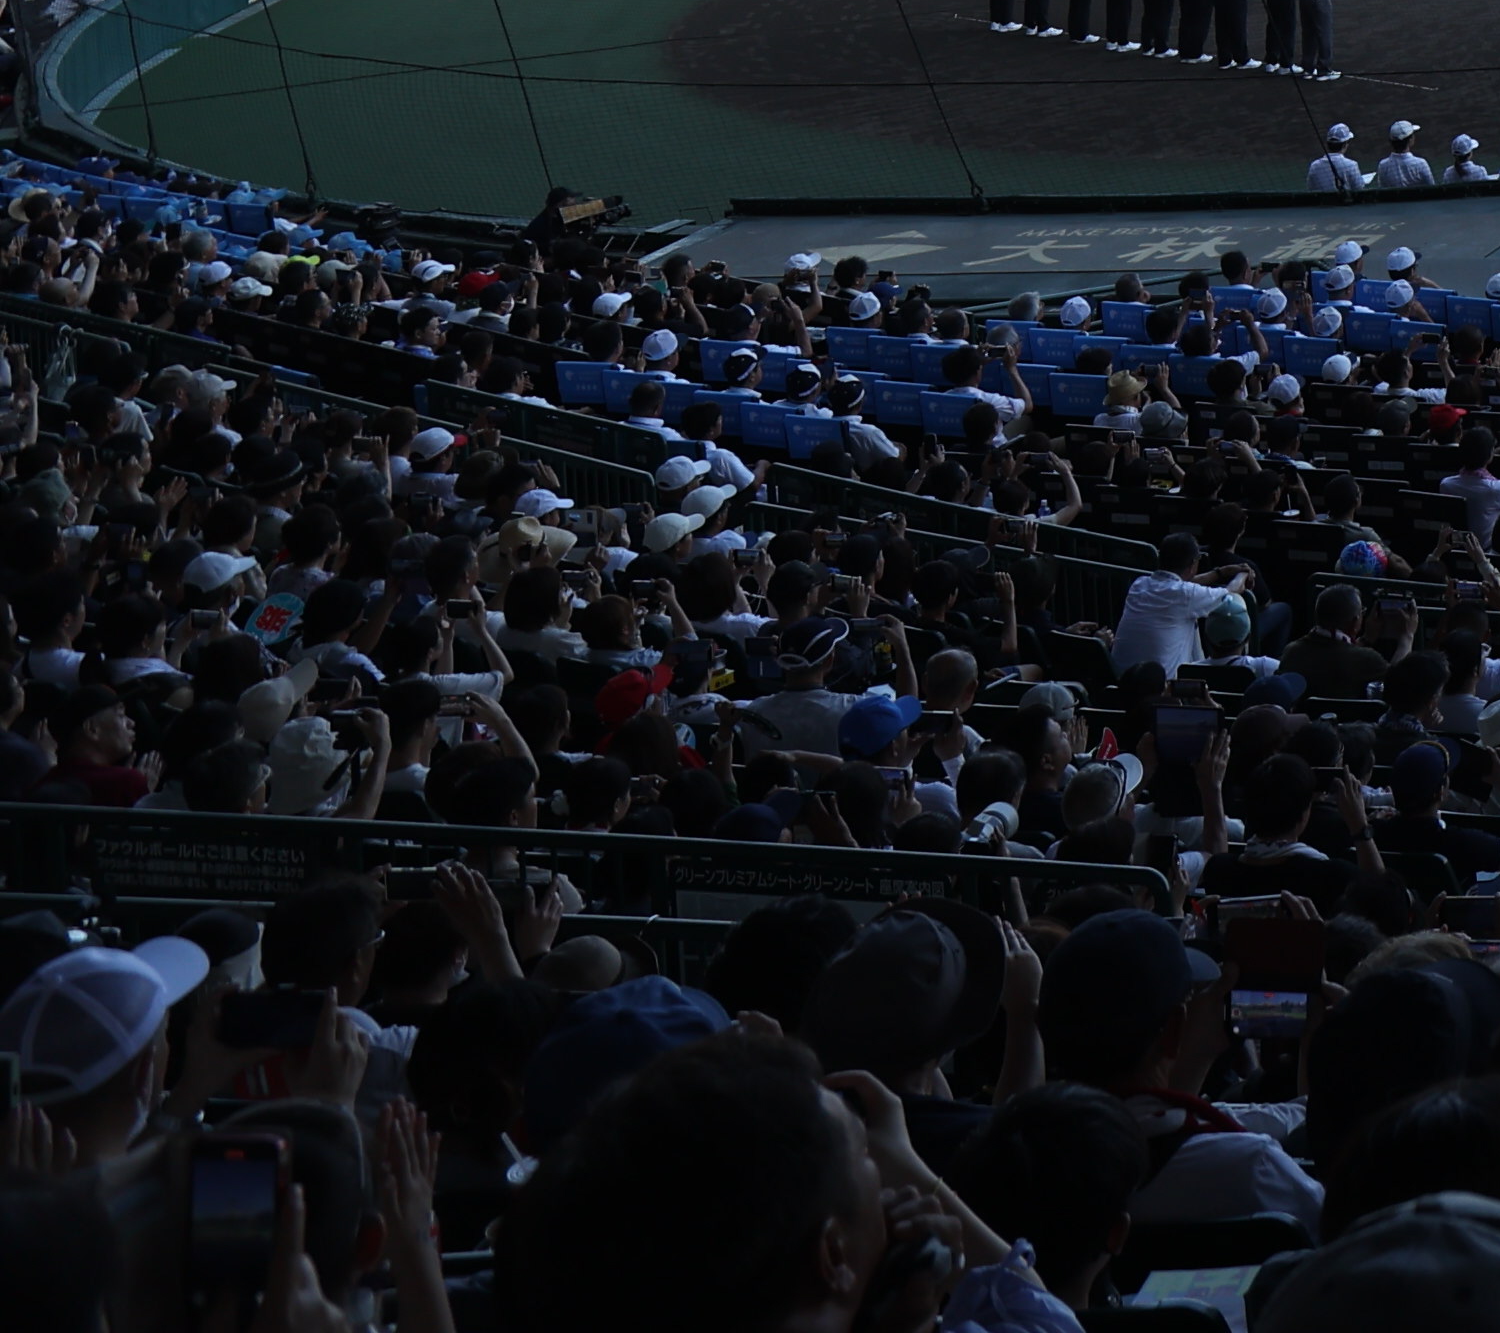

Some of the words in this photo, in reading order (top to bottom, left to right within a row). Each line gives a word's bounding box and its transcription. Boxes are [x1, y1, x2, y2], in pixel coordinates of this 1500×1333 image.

[1016, 225, 1106, 238] MAKE
[1108, 223, 1233, 238] BEYOND
[962, 234, 1387, 266] 大林組
[95, 837, 305, 863] ファウルボールにご注意ください
